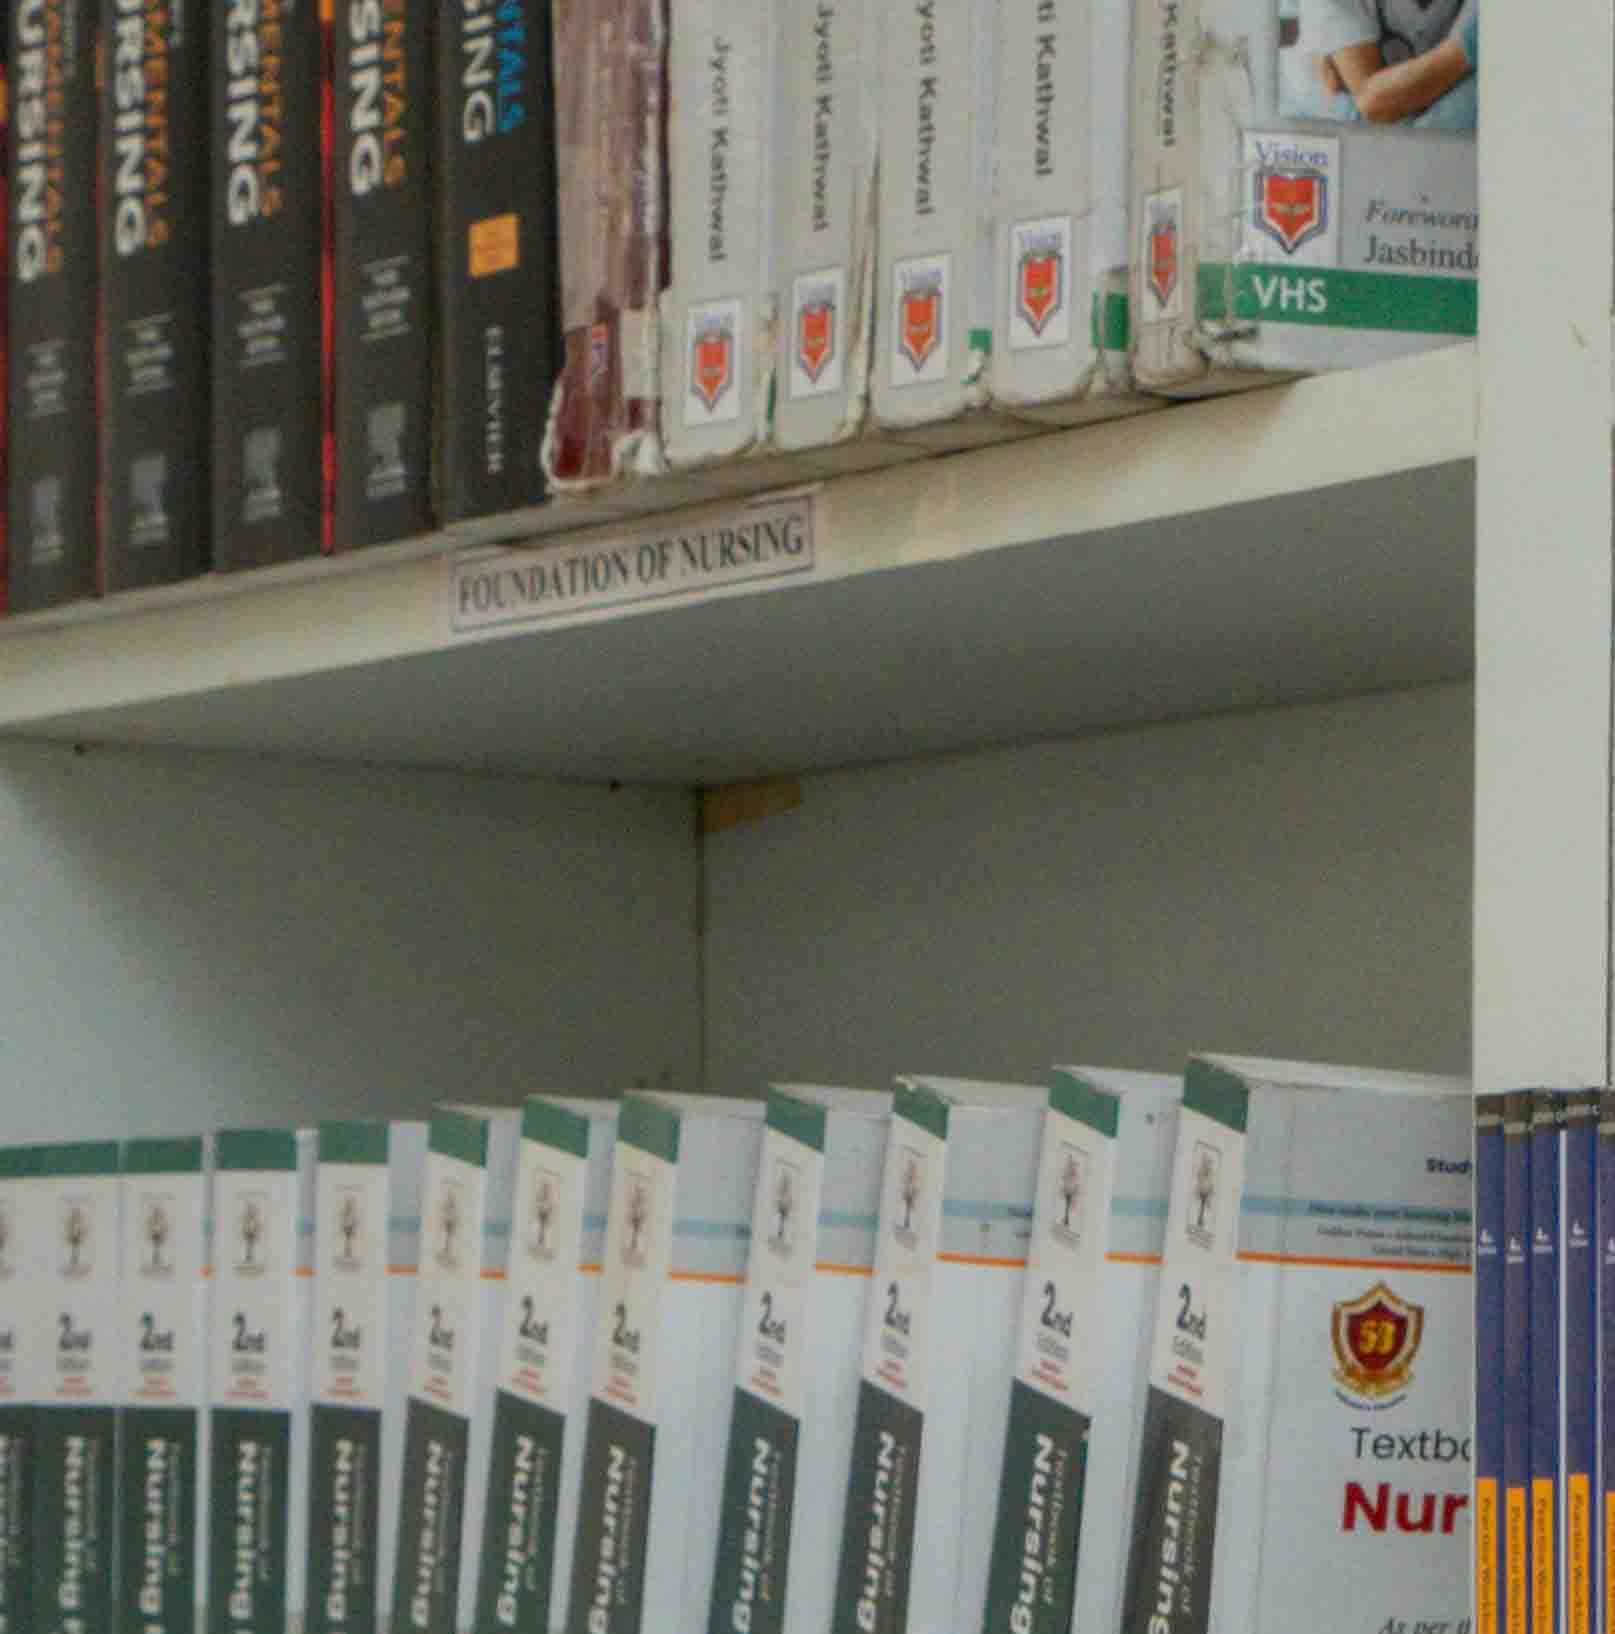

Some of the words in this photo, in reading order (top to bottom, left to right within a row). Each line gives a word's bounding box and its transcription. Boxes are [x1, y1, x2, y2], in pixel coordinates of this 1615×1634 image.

[709, 36, 729, 117] Jyoti
[1035, 36, 1055, 176] Kathwal
[709, 127, 729, 260] Kathwal
[812, 85, 832, 231] Kathwal
[915, 67, 935, 216] Kathwal
[1255, 141, 1328, 168] Vision
[1252, 274, 1327, 312] VHS
[457, 553, 628, 615] FOUNDATION
[637, 543, 671, 582] OF
[677, 515, 805, 573] NURSING
